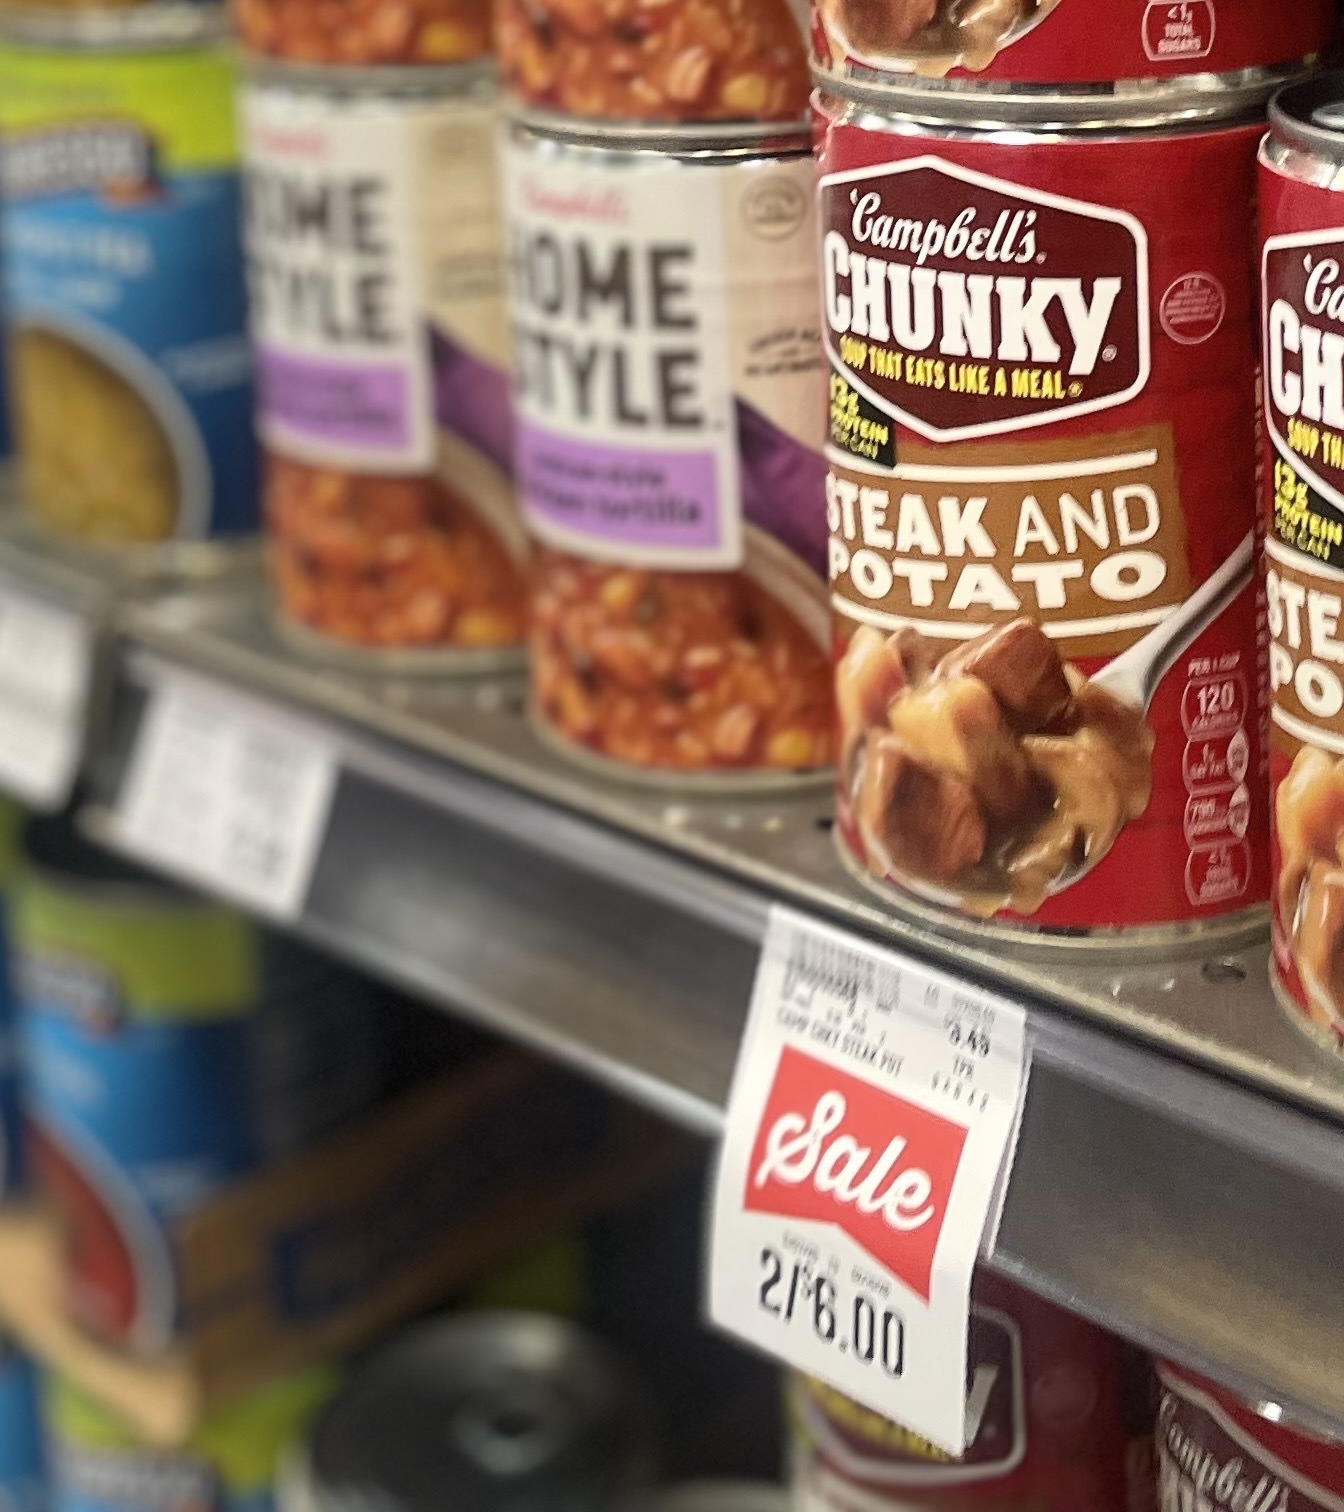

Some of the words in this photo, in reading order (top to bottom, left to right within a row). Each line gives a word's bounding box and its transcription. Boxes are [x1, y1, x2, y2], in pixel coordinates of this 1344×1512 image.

[850, 187, 1038, 266] Campbell's
[822, 229, 1123, 377] CHUNKY
[839, 334, 865, 370] SOUP
[867, 342, 904, 382] THAT
[906, 356, 946, 393] EATS
[948, 363, 991, 397] LIKE
[993, 368, 1009, 396] A
[1011, 366, 1068, 401] MEAL
[1286, 416, 1320, 460] SOUP
[827, 469, 999, 560] STEAK
[1012, 482, 1161, 558] AND
[827, 538, 1169, 613] POTATO
[1196, 680, 1235, 718] 120
[754, 1088, 936, 1233] Sale
